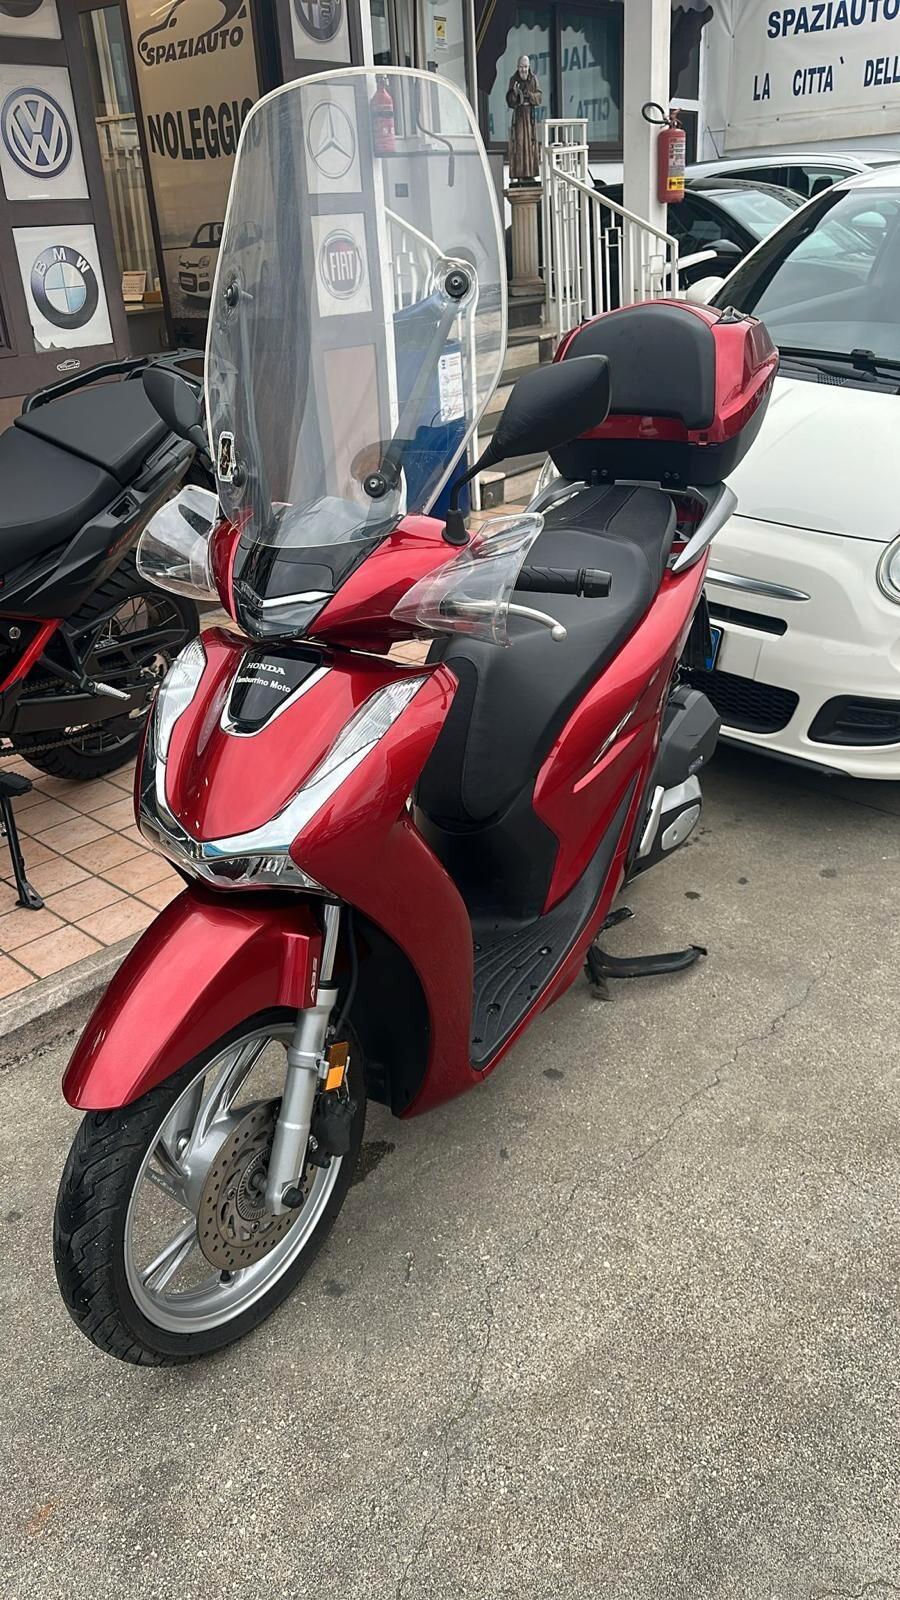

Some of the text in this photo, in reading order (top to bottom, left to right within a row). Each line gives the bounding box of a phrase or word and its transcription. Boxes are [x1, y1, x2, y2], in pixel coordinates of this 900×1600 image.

[767, 0, 900, 39] SPAZIAUTO
[146, 26, 244, 66] SPAZIAUTO
[753, 72, 771, 101] LA
[147, 97, 264, 161] NOLEGGIO
[34, 247, 91, 277] BMW
[329, 250, 355, 282] FIAT
[246, 662, 286, 676] HONDA
[269, 679, 292, 693] Moto
